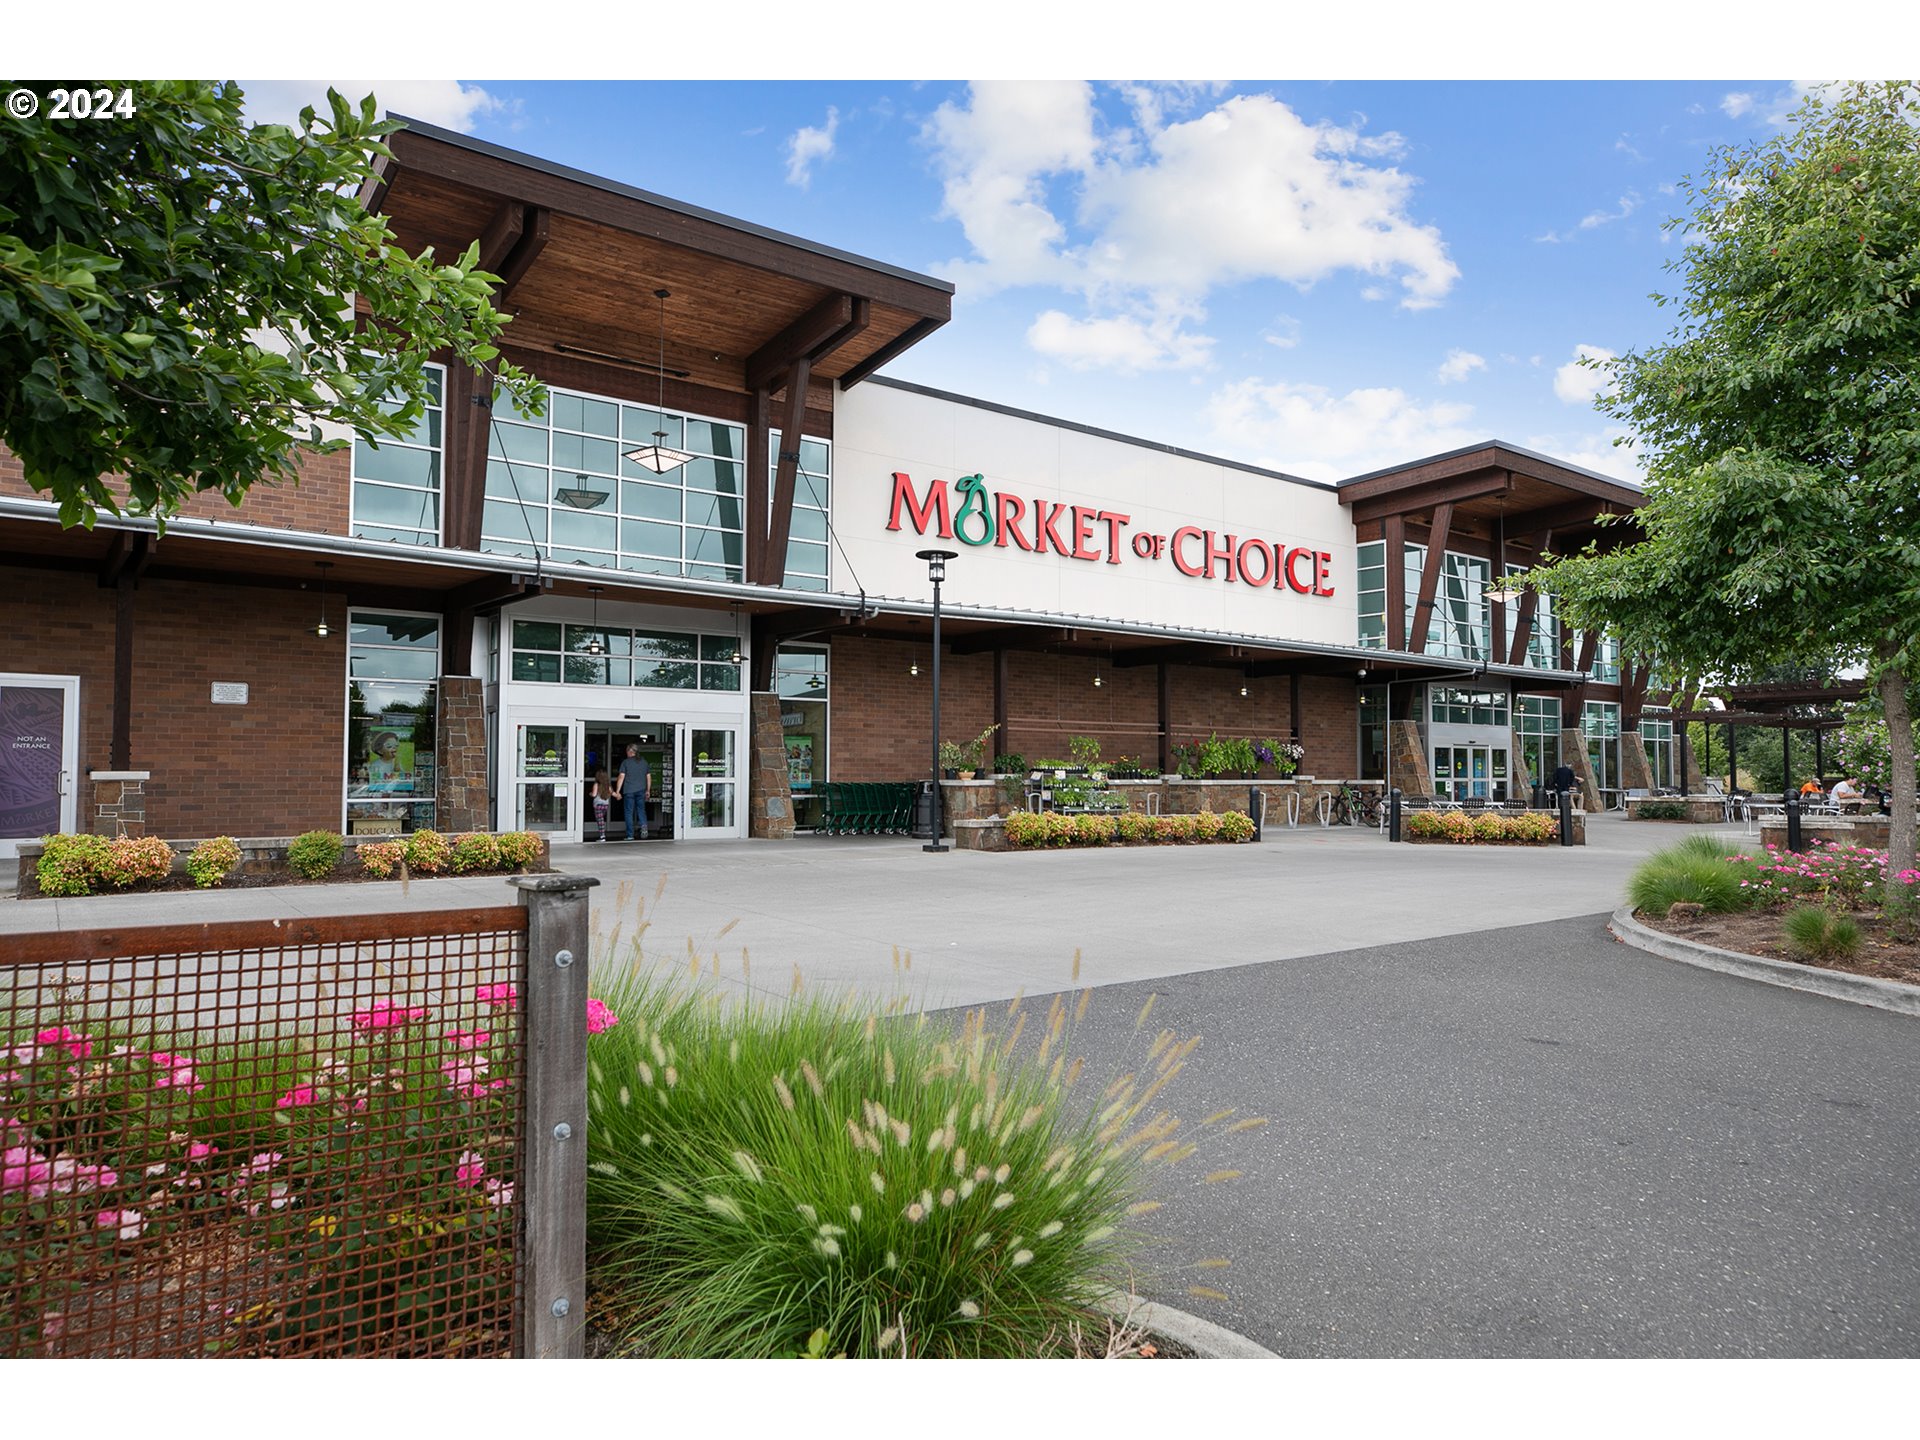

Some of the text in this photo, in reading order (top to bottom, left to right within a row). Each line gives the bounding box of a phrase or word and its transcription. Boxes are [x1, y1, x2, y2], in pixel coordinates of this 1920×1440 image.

[885, 471, 1336, 598] MARKET OF CHOICE
[355, 826, 401, 835] DOUGLAS
